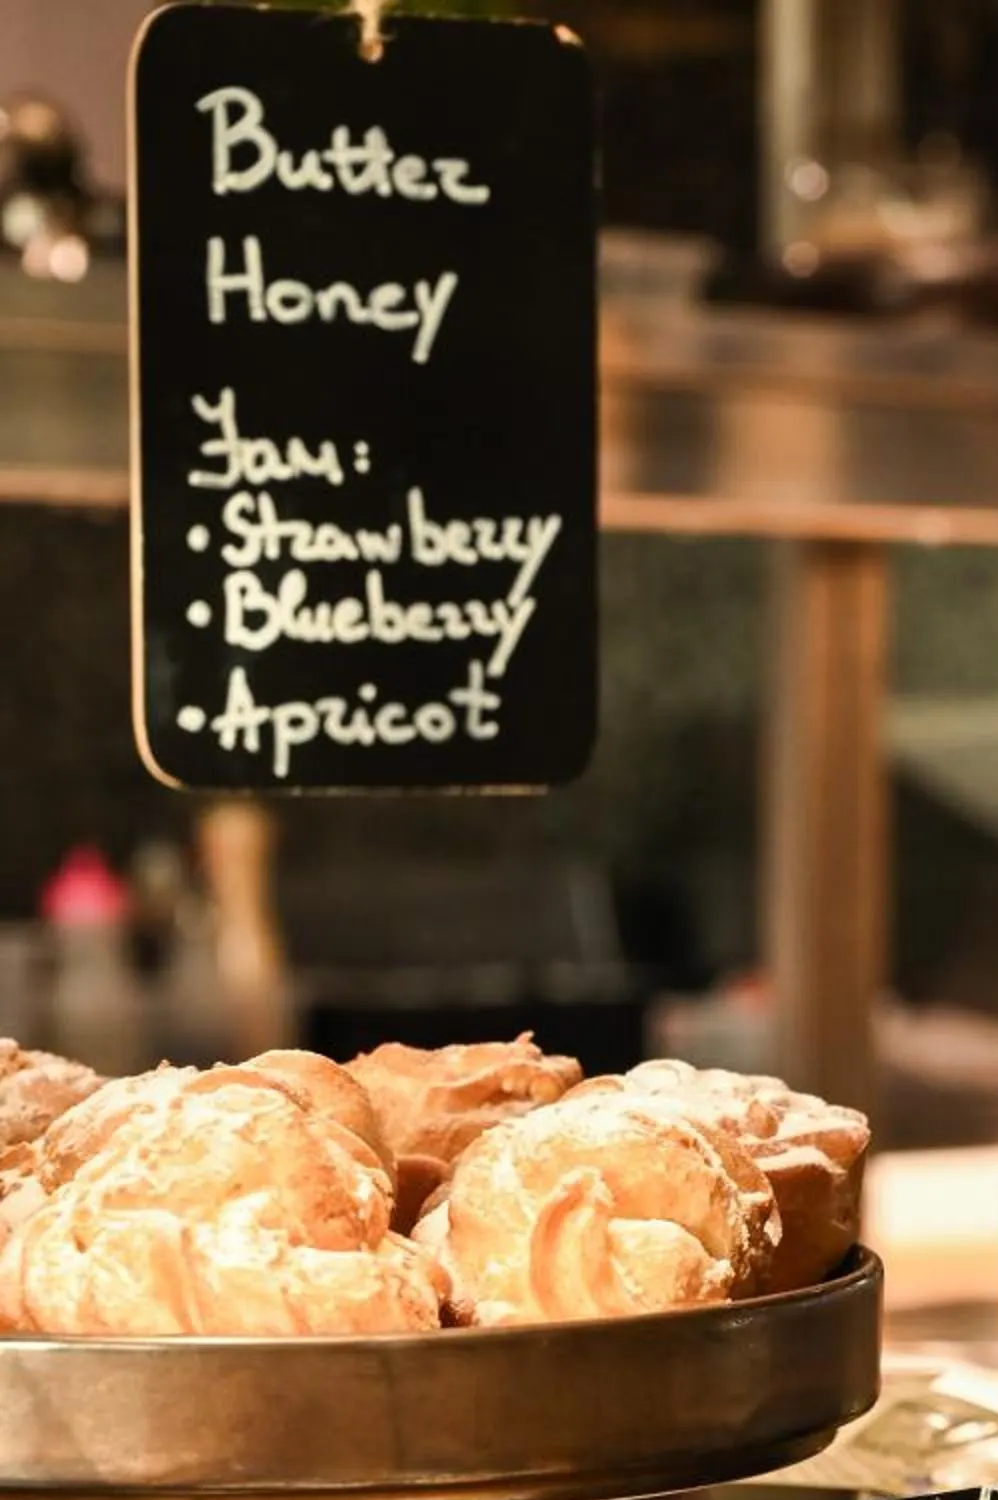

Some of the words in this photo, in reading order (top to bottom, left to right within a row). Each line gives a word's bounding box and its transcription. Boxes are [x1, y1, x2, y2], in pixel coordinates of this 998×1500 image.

[197, 86, 490, 203] Butter
[206, 235, 458, 363] Honey
[222, 487, 561, 600] Strawberry
[224, 570, 536, 676] Blueberry
[211, 660, 501, 777] Apricot
